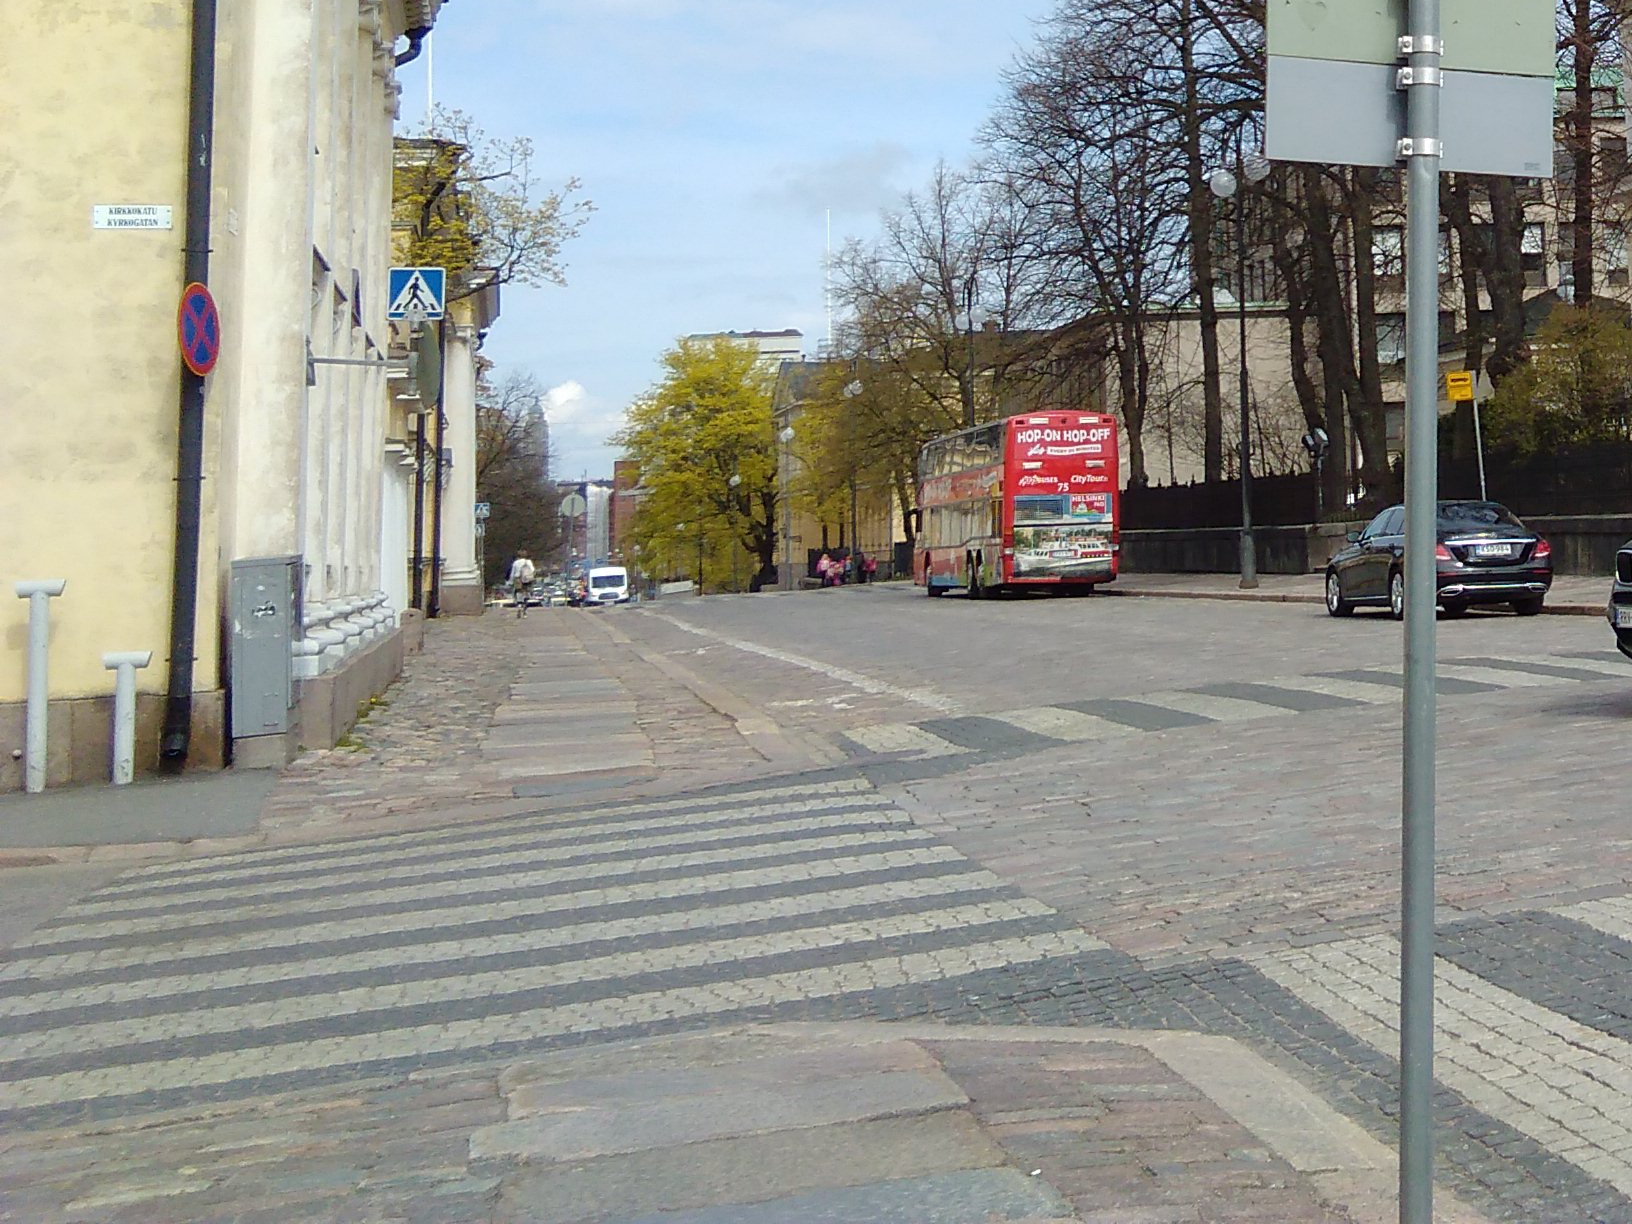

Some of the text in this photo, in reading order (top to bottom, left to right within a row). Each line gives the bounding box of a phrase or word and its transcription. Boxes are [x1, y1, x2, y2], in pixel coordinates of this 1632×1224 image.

[109, 207, 157, 215] KIRKKOKATU
[1017, 428, 1110, 443] HOP-ON HOP-OFF
[1057, 482, 1069, 492] 75
